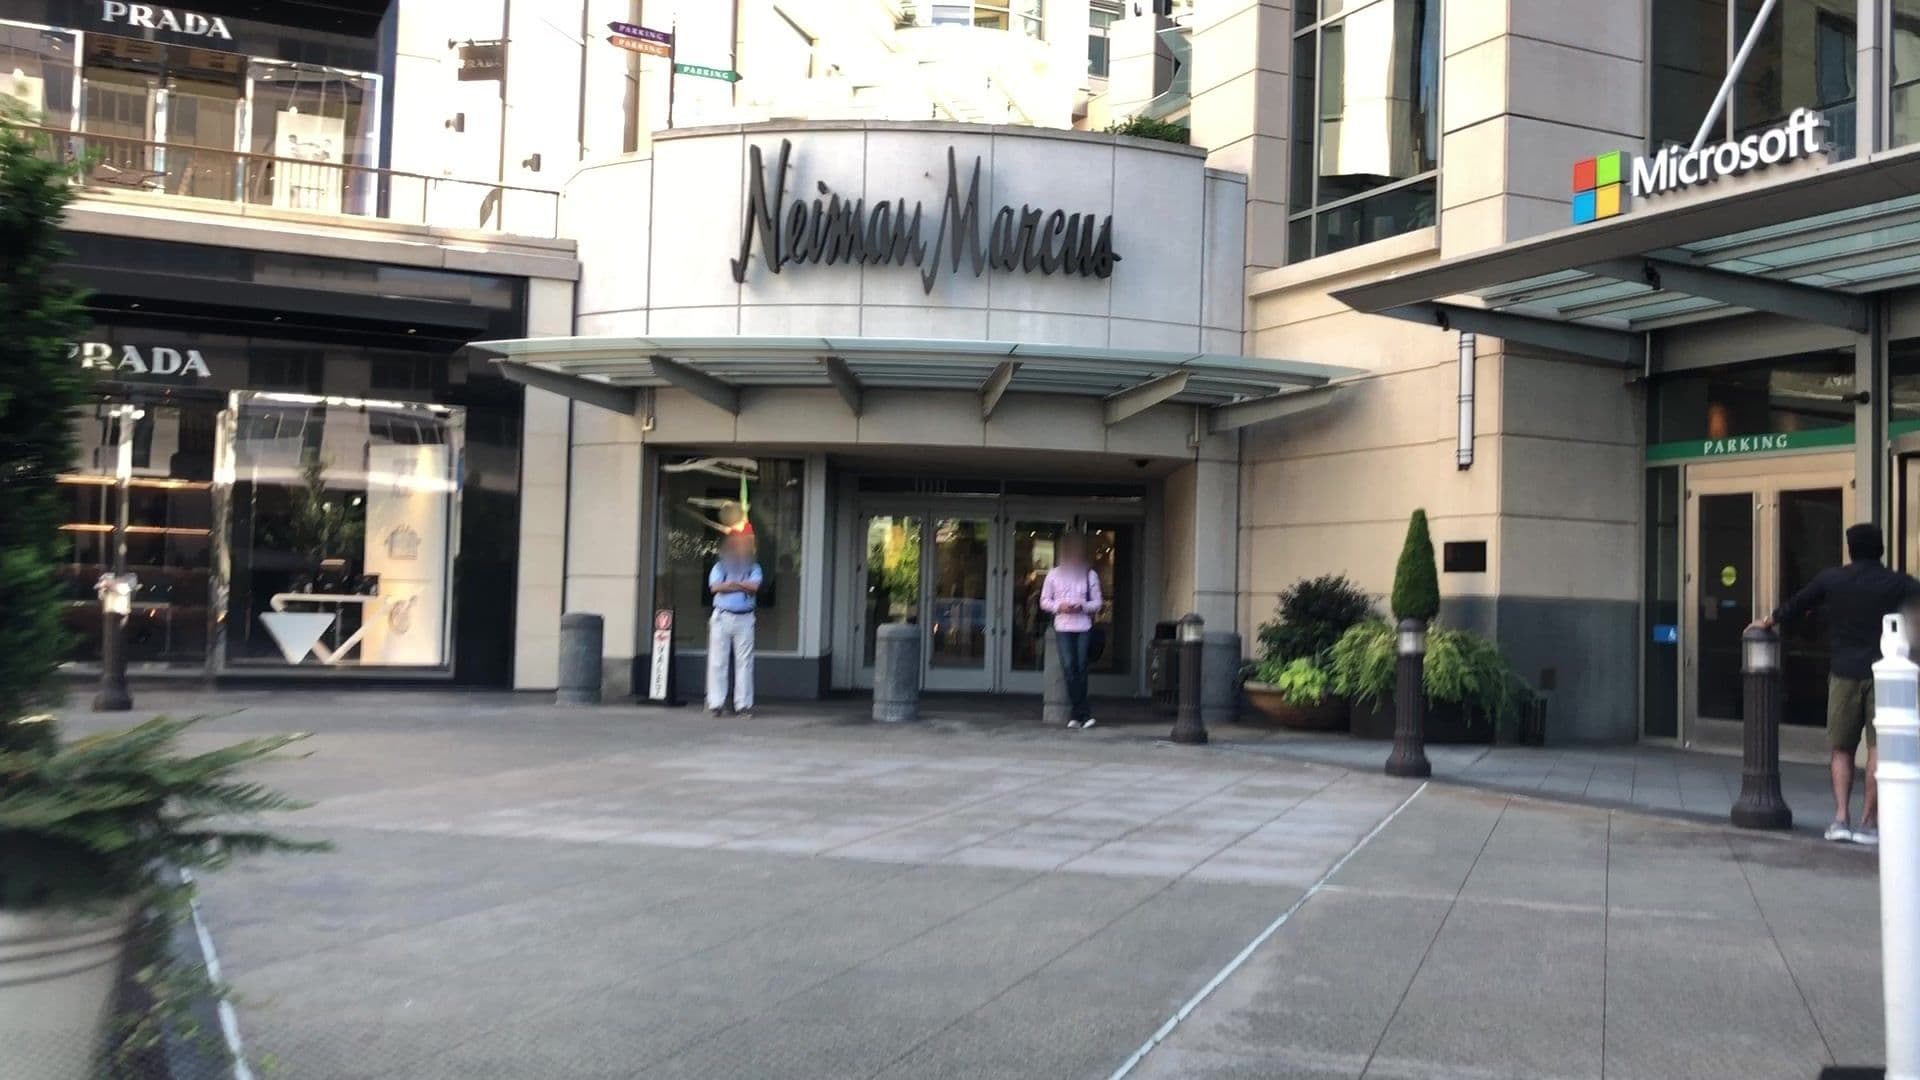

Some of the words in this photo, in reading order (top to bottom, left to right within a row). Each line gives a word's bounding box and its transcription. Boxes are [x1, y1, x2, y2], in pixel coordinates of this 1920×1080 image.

[101, 0, 233, 40] PRADA
[618, 24, 665, 41] PARKING
[618, 38, 664, 54] PARKING
[682, 65, 730, 80] PARKING
[1632, 106, 1820, 197] Microsoft
[731, 139, 925, 283] Neiman
[922, 145, 1122, 296] Marcus
[1703, 433, 1789, 456] PARKING
